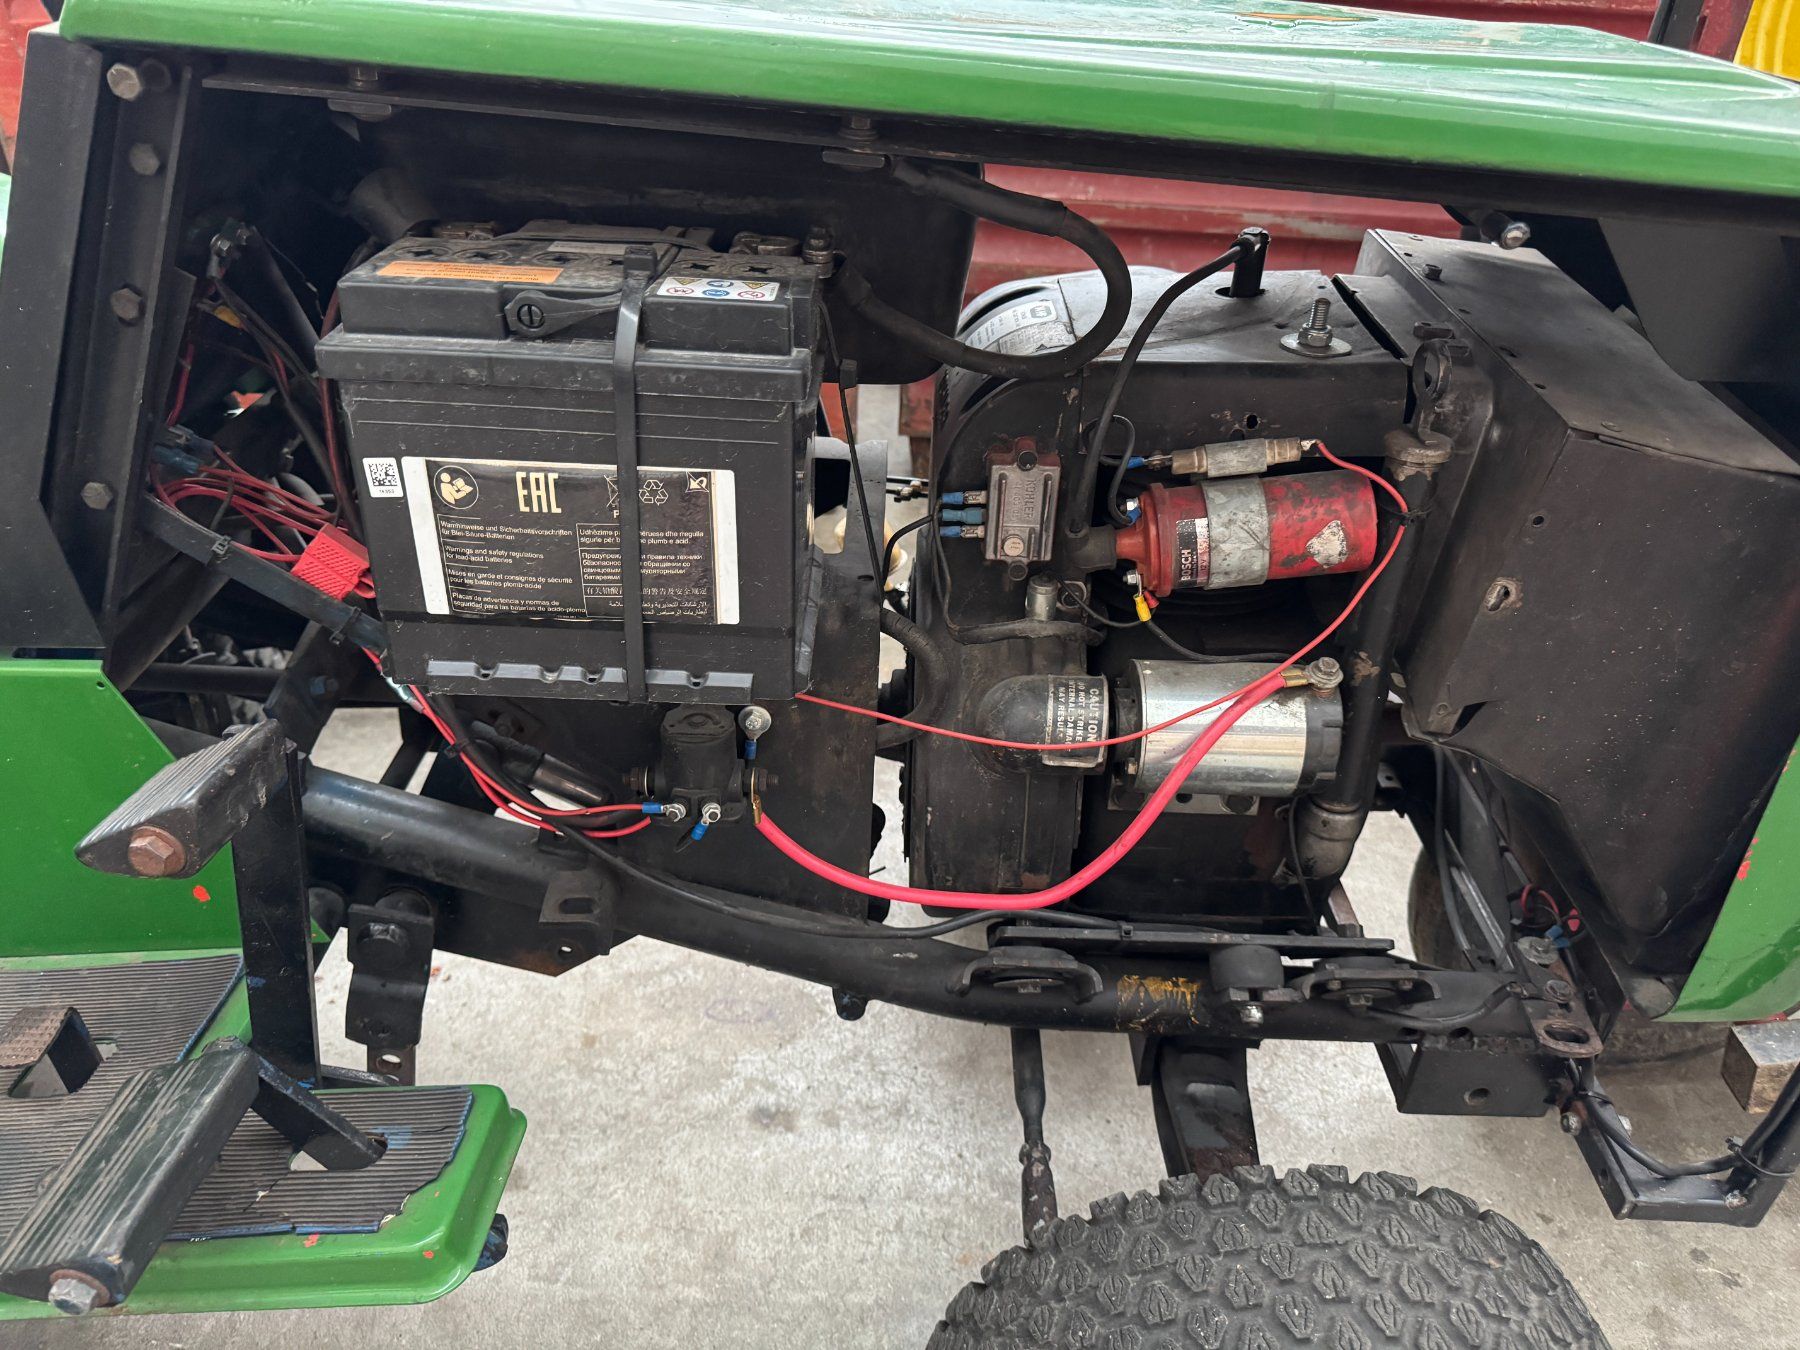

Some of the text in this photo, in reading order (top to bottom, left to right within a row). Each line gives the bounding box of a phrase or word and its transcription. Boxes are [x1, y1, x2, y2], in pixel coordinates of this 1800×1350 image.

[515, 471, 562, 513] EAC
[1024, 480, 1036, 519] KOHLER
[440, 520, 485, 531] Warnhinweise
[499, 526, 573, 536] Sicherheitsvorschriften
[445, 545, 474, 555] Warnings
[488, 548, 508, 557] safety
[509, 550, 544, 559] regulations
[455, 553, 484, 562] lead-acid
[484, 555, 513, 564] batteries
[1180, 549, 1191, 581] BOSCH
[448, 569, 467, 577] Mises
[504, 574, 537, 583] consignes
[464, 577, 474, 585] les
[474, 579, 502, 587] batteries
[503, 580, 542, 589] plomb-acide
[452, 592, 473, 600] Placas
[483, 596, 520, 605] advertencia
[453, 600, 483, 609] seguridad
[1058, 686, 1066, 702] MAY
[1078, 691, 1086, 707] NOT
[1087, 688, 1099, 742] CAUTION
[1076, 708, 1085, 742] STRIKE
